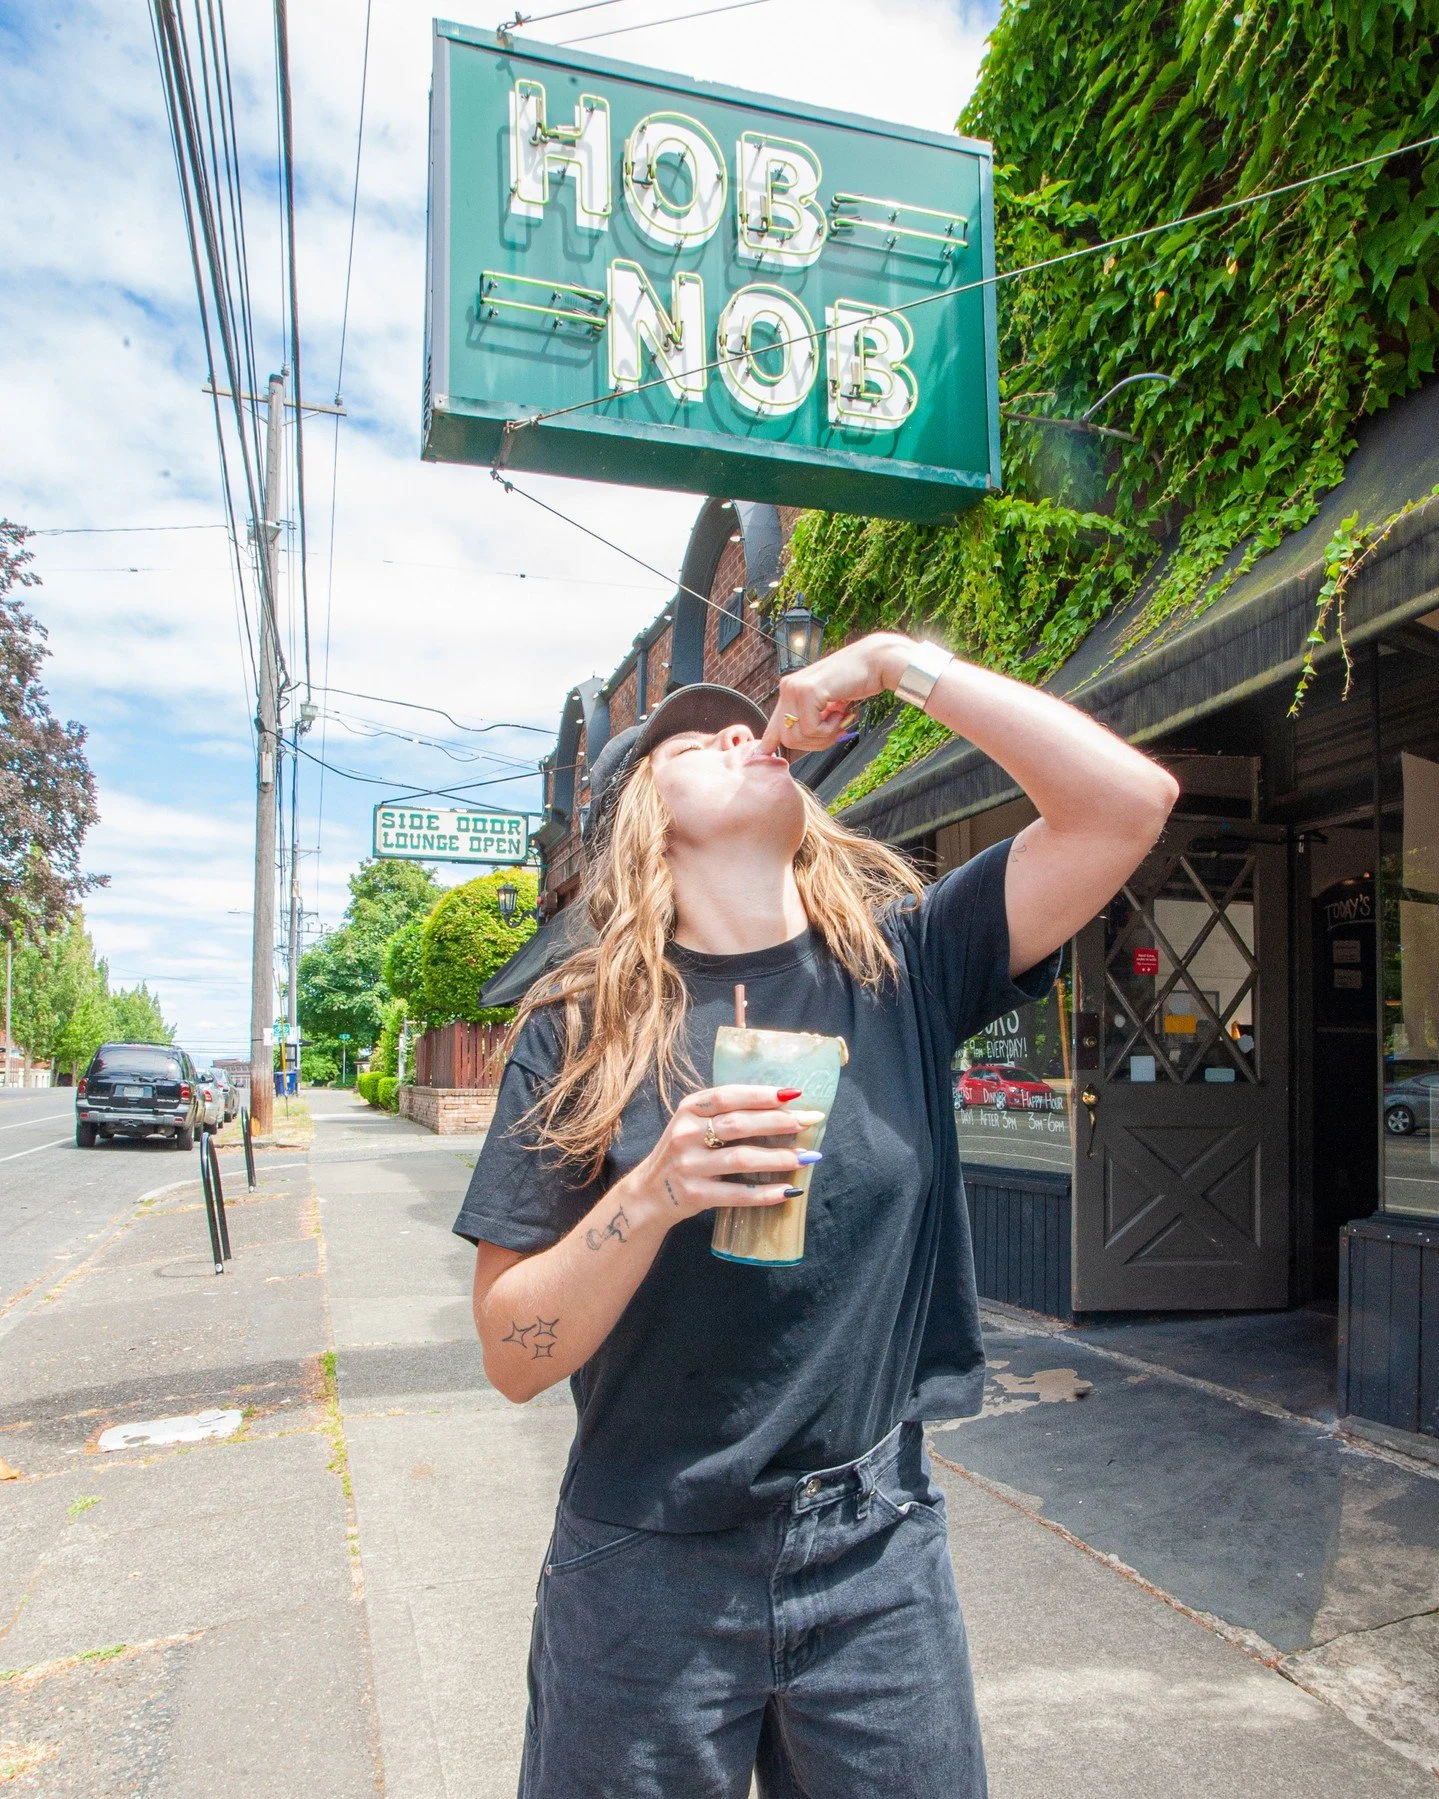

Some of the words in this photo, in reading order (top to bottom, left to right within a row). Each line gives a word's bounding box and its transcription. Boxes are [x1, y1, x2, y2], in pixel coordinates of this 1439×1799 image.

[509, 79, 828, 268] HOB
[607, 258, 919, 430] NOB
[381, 812, 440, 830] SIDE
[456, 816, 522, 835] DOOR
[383, 832, 460, 851] LOUNGE
[469, 836, 522, 854] OPEN
[1324, 894, 1370, 927] TODAY'S
[986, 1037, 1028, 1059] EVERYDAY!
[1021, 1089, 1044, 1109] HAPPY
[1044, 1092, 1064, 1110] HOUR
[980, 1109, 1000, 1128] AFTER
[1000, 1111, 1018, 1130] 3PM
